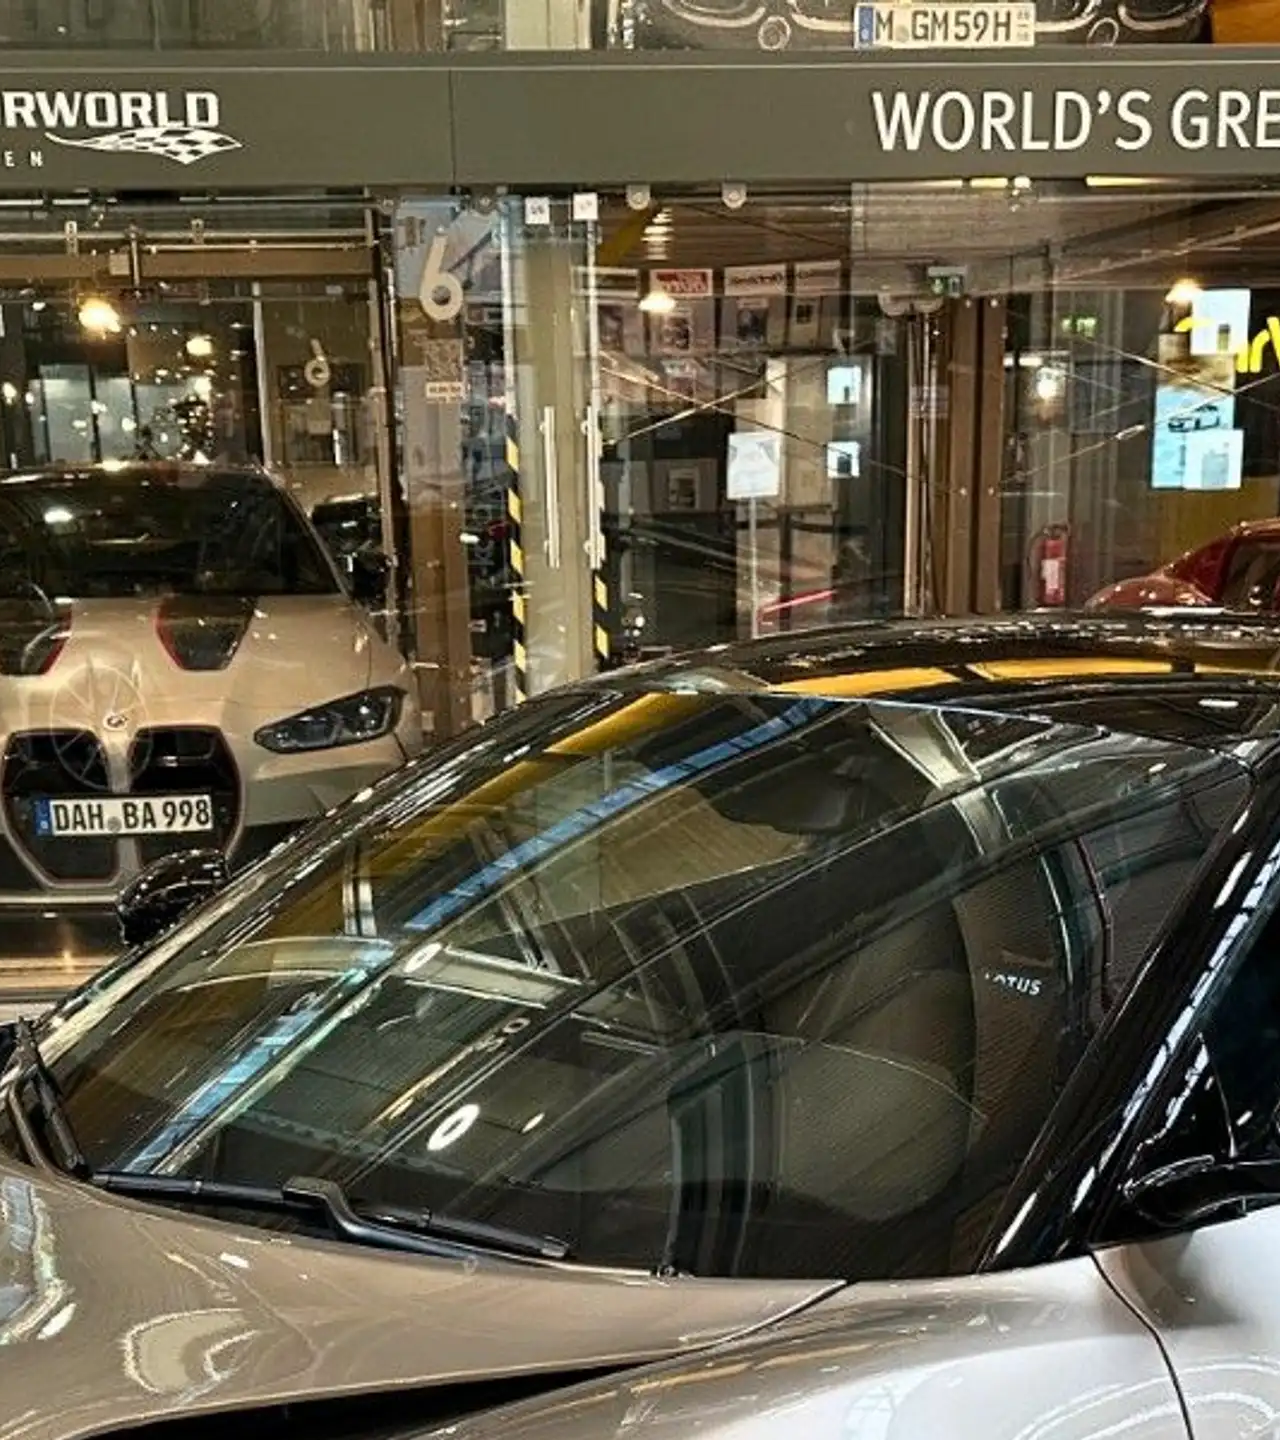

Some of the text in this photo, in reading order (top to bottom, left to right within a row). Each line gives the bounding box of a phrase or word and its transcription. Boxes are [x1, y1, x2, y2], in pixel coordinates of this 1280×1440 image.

[872, 88, 1152, 151] WORLD'S
[419, 235, 464, 323] 6
[52, 799, 211, 832] DAH BA 998
